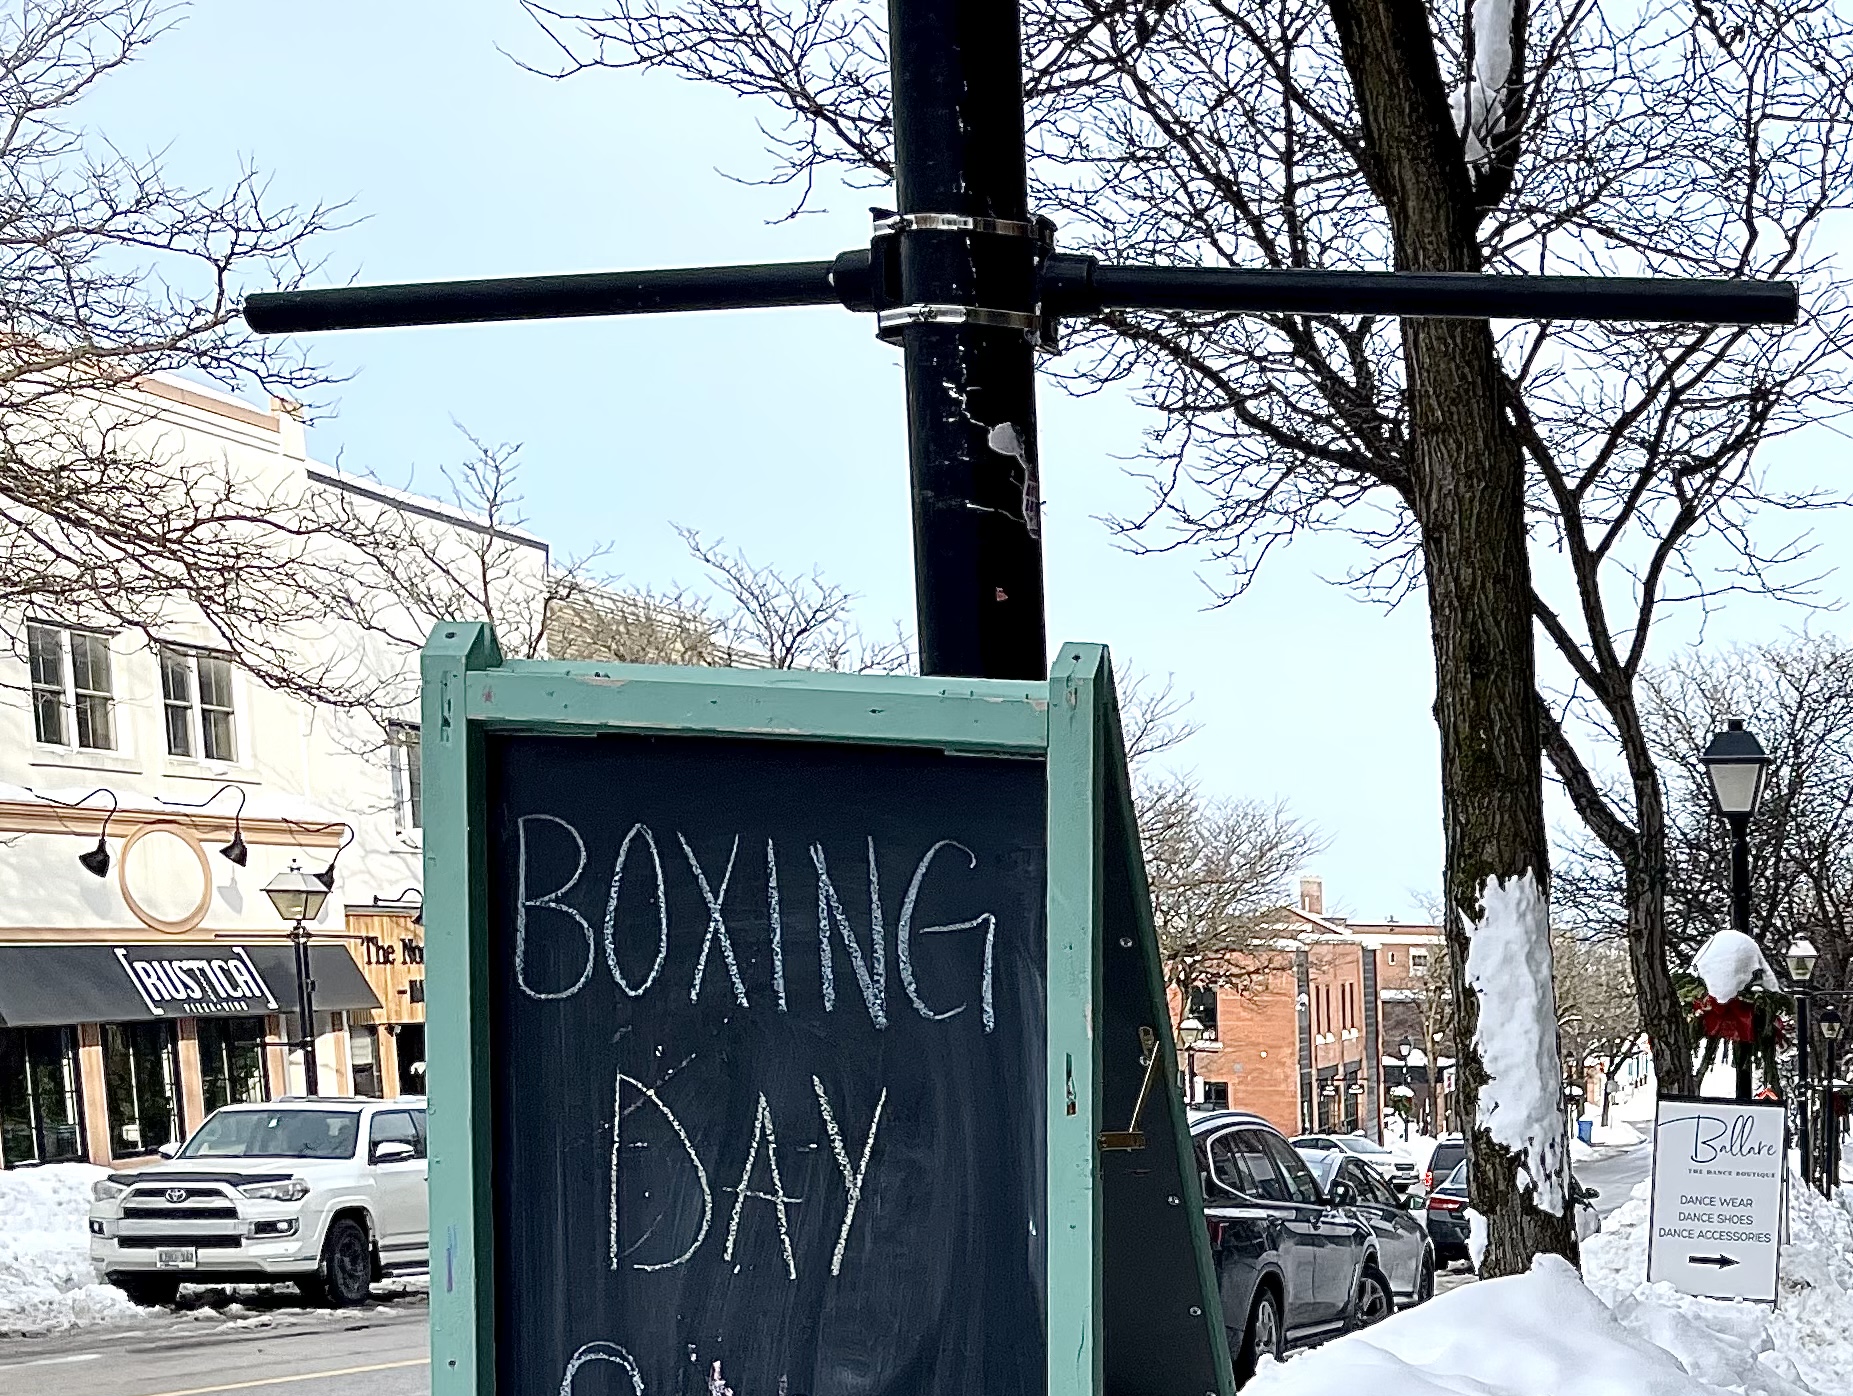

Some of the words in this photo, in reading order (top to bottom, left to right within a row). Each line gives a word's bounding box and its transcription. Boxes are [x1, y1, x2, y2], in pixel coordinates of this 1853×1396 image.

[514, 813, 996, 1034] BOXING
[361, 935, 396, 965] The
[1658, 1113, 1777, 1163] Ballare
[609, 1068, 887, 1281] DAY
[1735, 1171, 1776, 1179] BOUTIQUE
[1680, 1194, 1716, 1207] DANCE
[1719, 1197, 1753, 1208] WEAR
[1678, 1211, 1713, 1224] DANCE
[1716, 1213, 1754, 1226] SHOES
[1658, 1227, 1694, 1239] DANCE
[1697, 1229, 1772, 1243] ACCESSORIES
